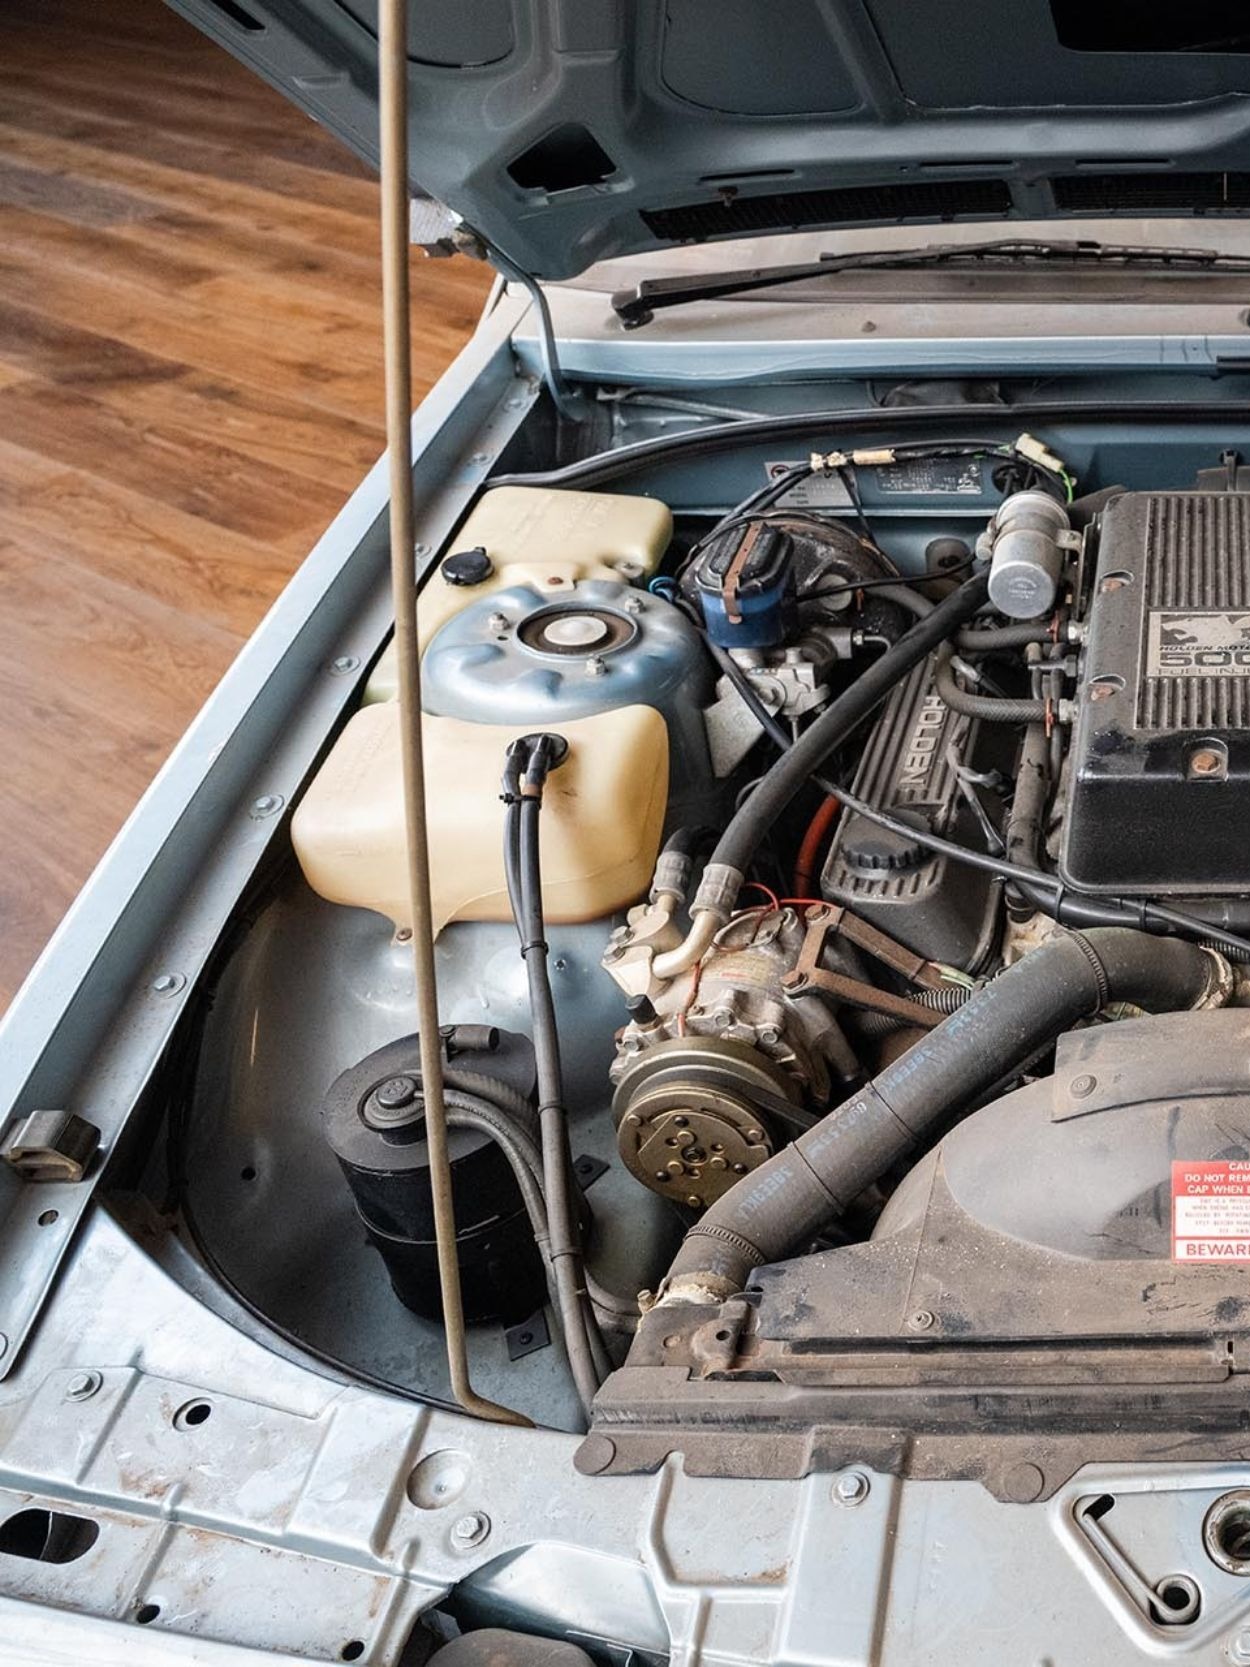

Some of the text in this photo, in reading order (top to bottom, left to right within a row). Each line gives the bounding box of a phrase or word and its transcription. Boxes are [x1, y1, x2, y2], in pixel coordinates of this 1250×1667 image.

[900, 695, 947, 785] HOLDEN
[1185, 1174, 1200, 1182] DO
[1204, 1174, 1224, 1182] NOT
[1187, 1186, 1208, 1194] CAP
[1212, 1186, 1243, 1194] WHEN
